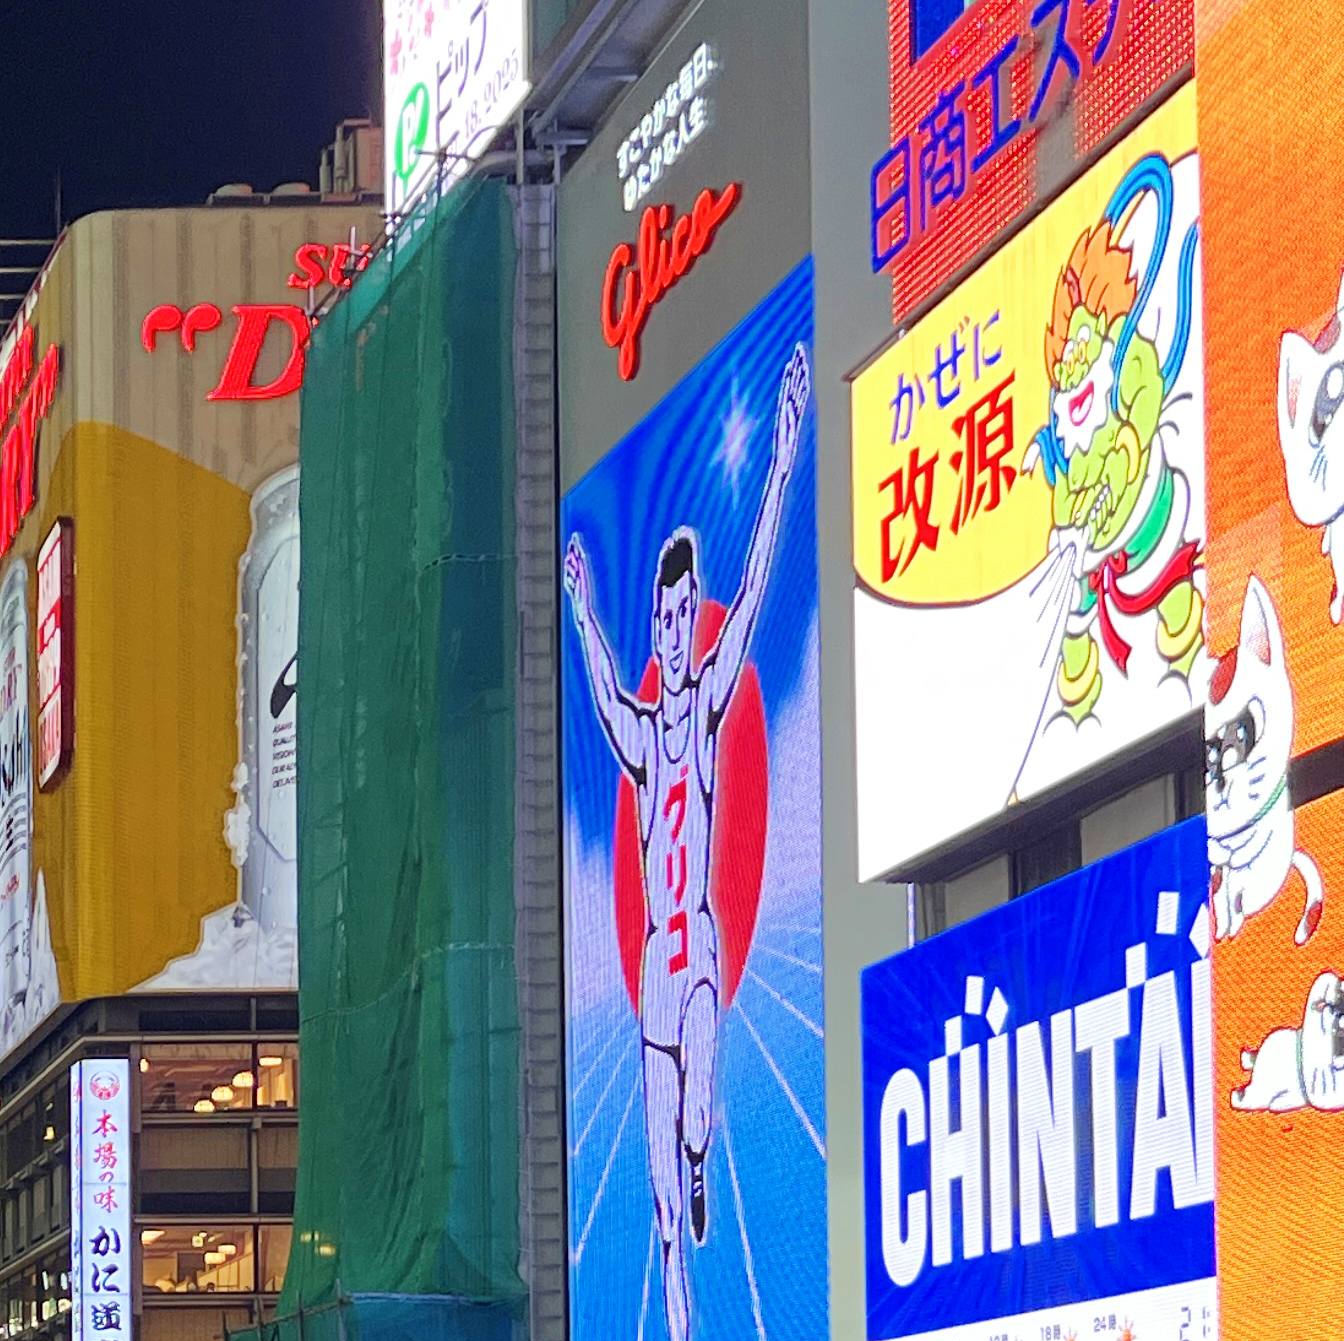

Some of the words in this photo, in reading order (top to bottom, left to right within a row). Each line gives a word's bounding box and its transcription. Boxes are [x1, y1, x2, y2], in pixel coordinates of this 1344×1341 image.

[602, 182, 740, 381] Glico
[889, 308, 1002, 445] かぜに
[878, 372, 1017, 583] 改源
[664, 765, 688, 975] グリコ
[92, 1109, 118, 1213] 本場の味
